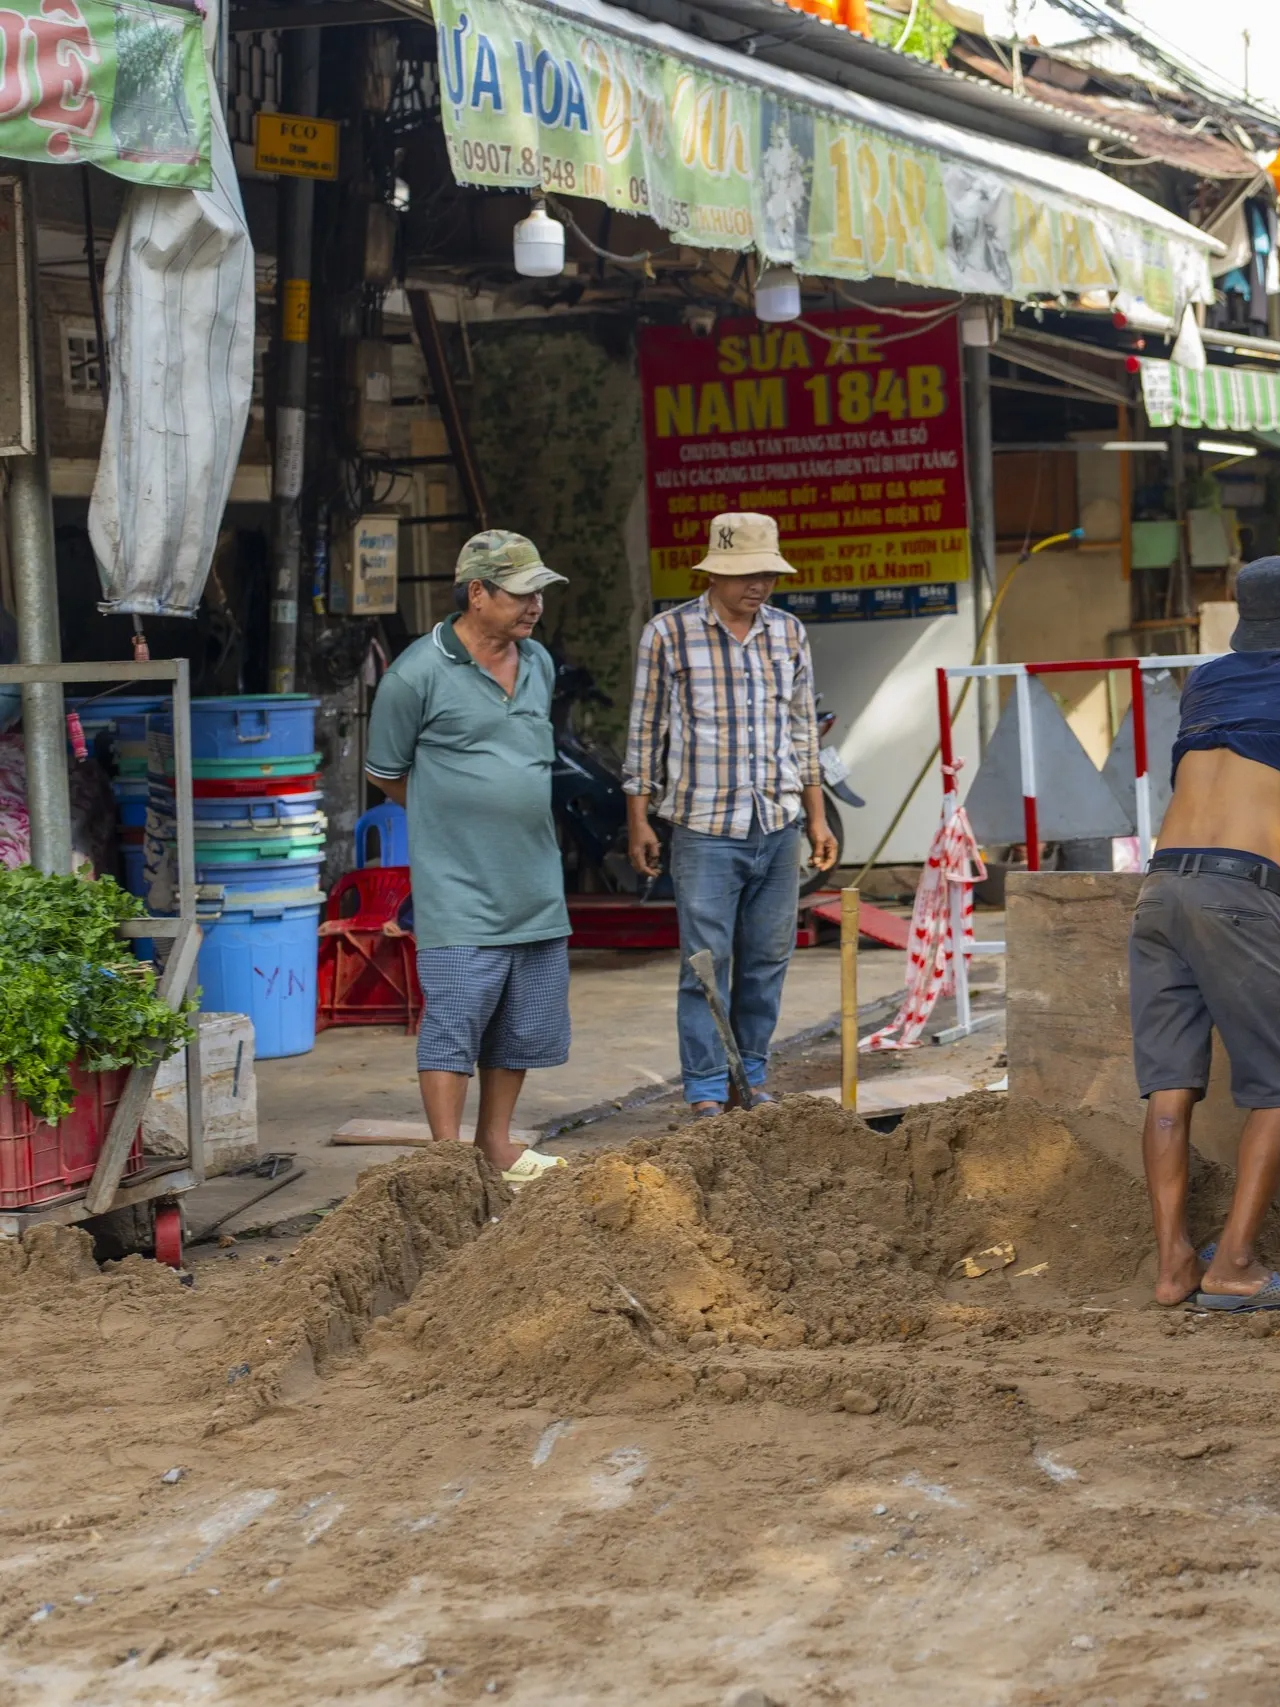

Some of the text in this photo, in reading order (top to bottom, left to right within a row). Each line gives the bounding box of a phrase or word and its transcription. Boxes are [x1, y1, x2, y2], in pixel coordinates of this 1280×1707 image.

[718, 324, 884, 374] SỬA XE
[654, 365, 945, 438] NAM 184B
[843, 431, 867, 449] TAY
[892, 428, 909, 446] XE
[885, 480, 906, 500] GA
